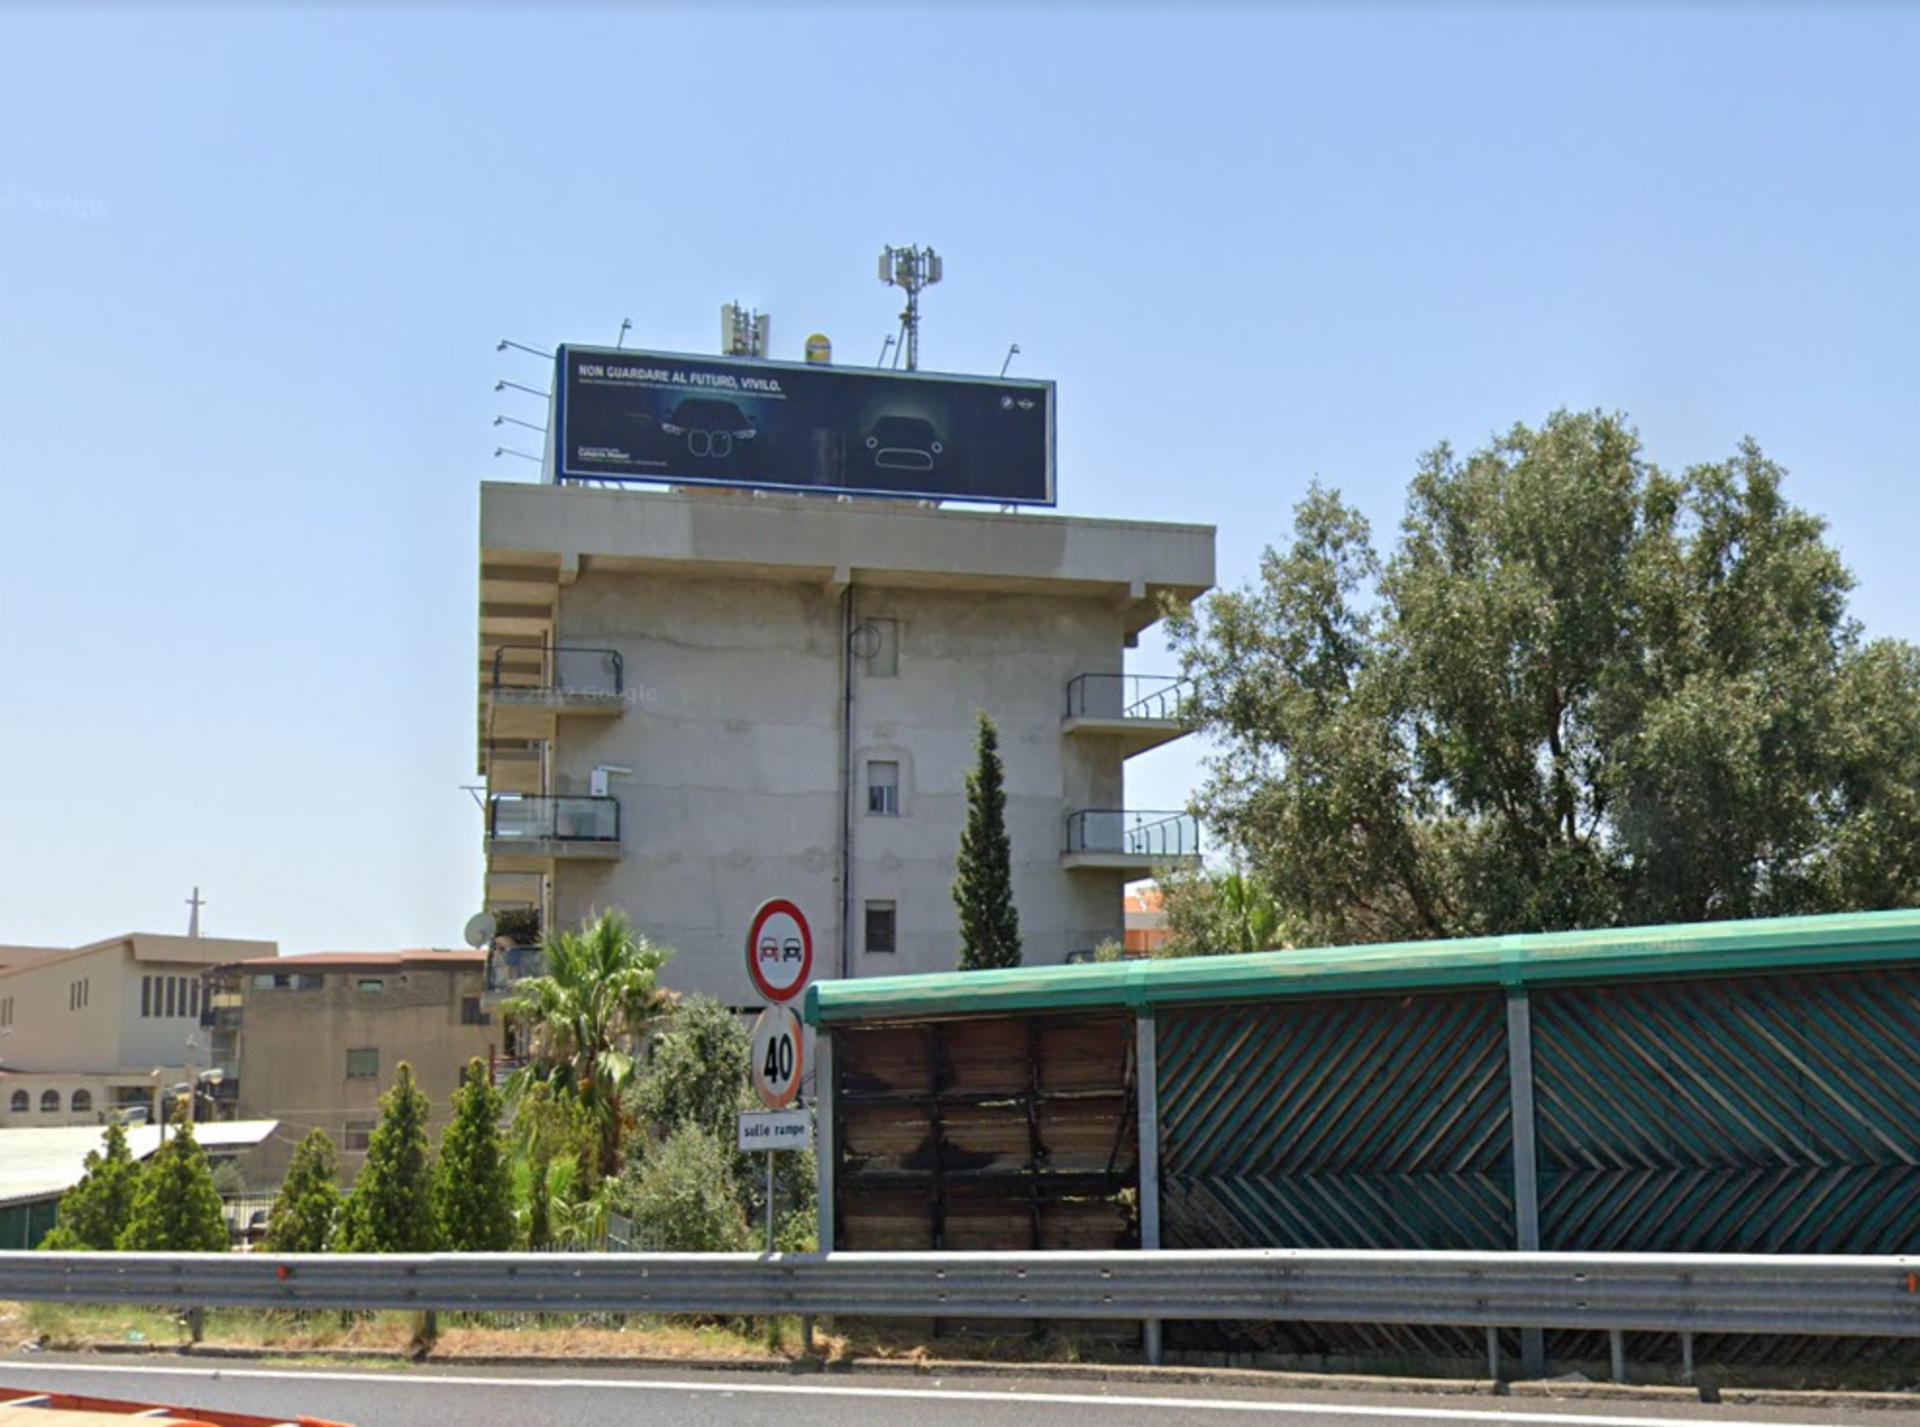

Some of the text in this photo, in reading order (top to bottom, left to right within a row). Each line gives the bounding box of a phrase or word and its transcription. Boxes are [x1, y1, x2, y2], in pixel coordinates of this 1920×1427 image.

[578, 365, 603, 377] NON
[606, 367, 669, 382] GUARDARE
[672, 372, 687, 383] AL
[690, 374, 738, 388] FUTURO,
[741, 379, 781, 391] VIVILO.
[764, 1034, 793, 1083] 40
[744, 1122, 805, 1138] sulle rampe
